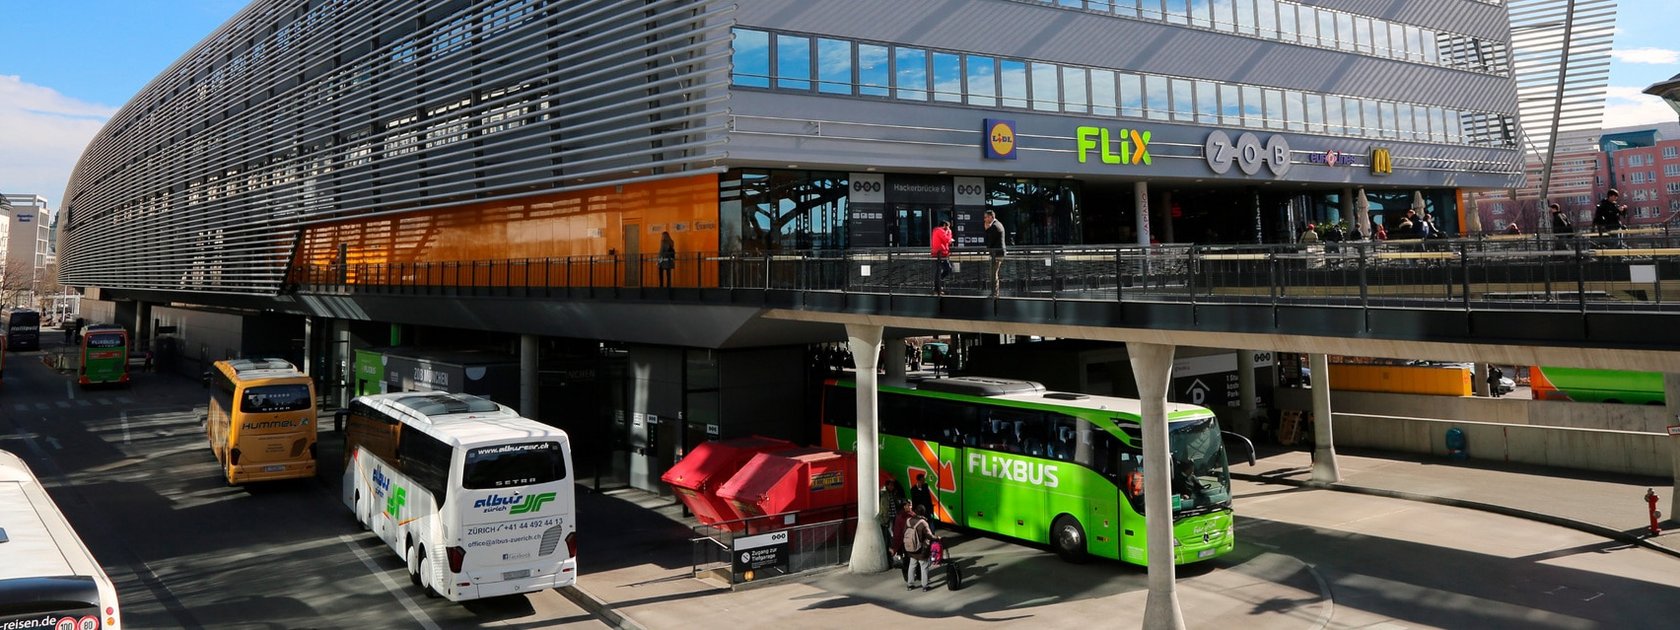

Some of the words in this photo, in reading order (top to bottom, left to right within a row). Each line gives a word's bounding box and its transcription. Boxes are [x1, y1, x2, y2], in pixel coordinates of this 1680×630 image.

[1211, 138, 1288, 169] ZOB
[893, 183, 939, 193] Hackerbrücke
[940, 185, 946, 193] 6
[496, 478, 536, 486] SETRA
[474, 494, 524, 508] albus
[483, 505, 507, 513] zürich
[468, 526, 496, 535] ZÜRICH
[504, 523, 517, 531] +41
[530, 520, 542, 528] 492
[468, 535, 542, 548] office@albus-zuerich.ch
[84, 620, 93, 630] 80
